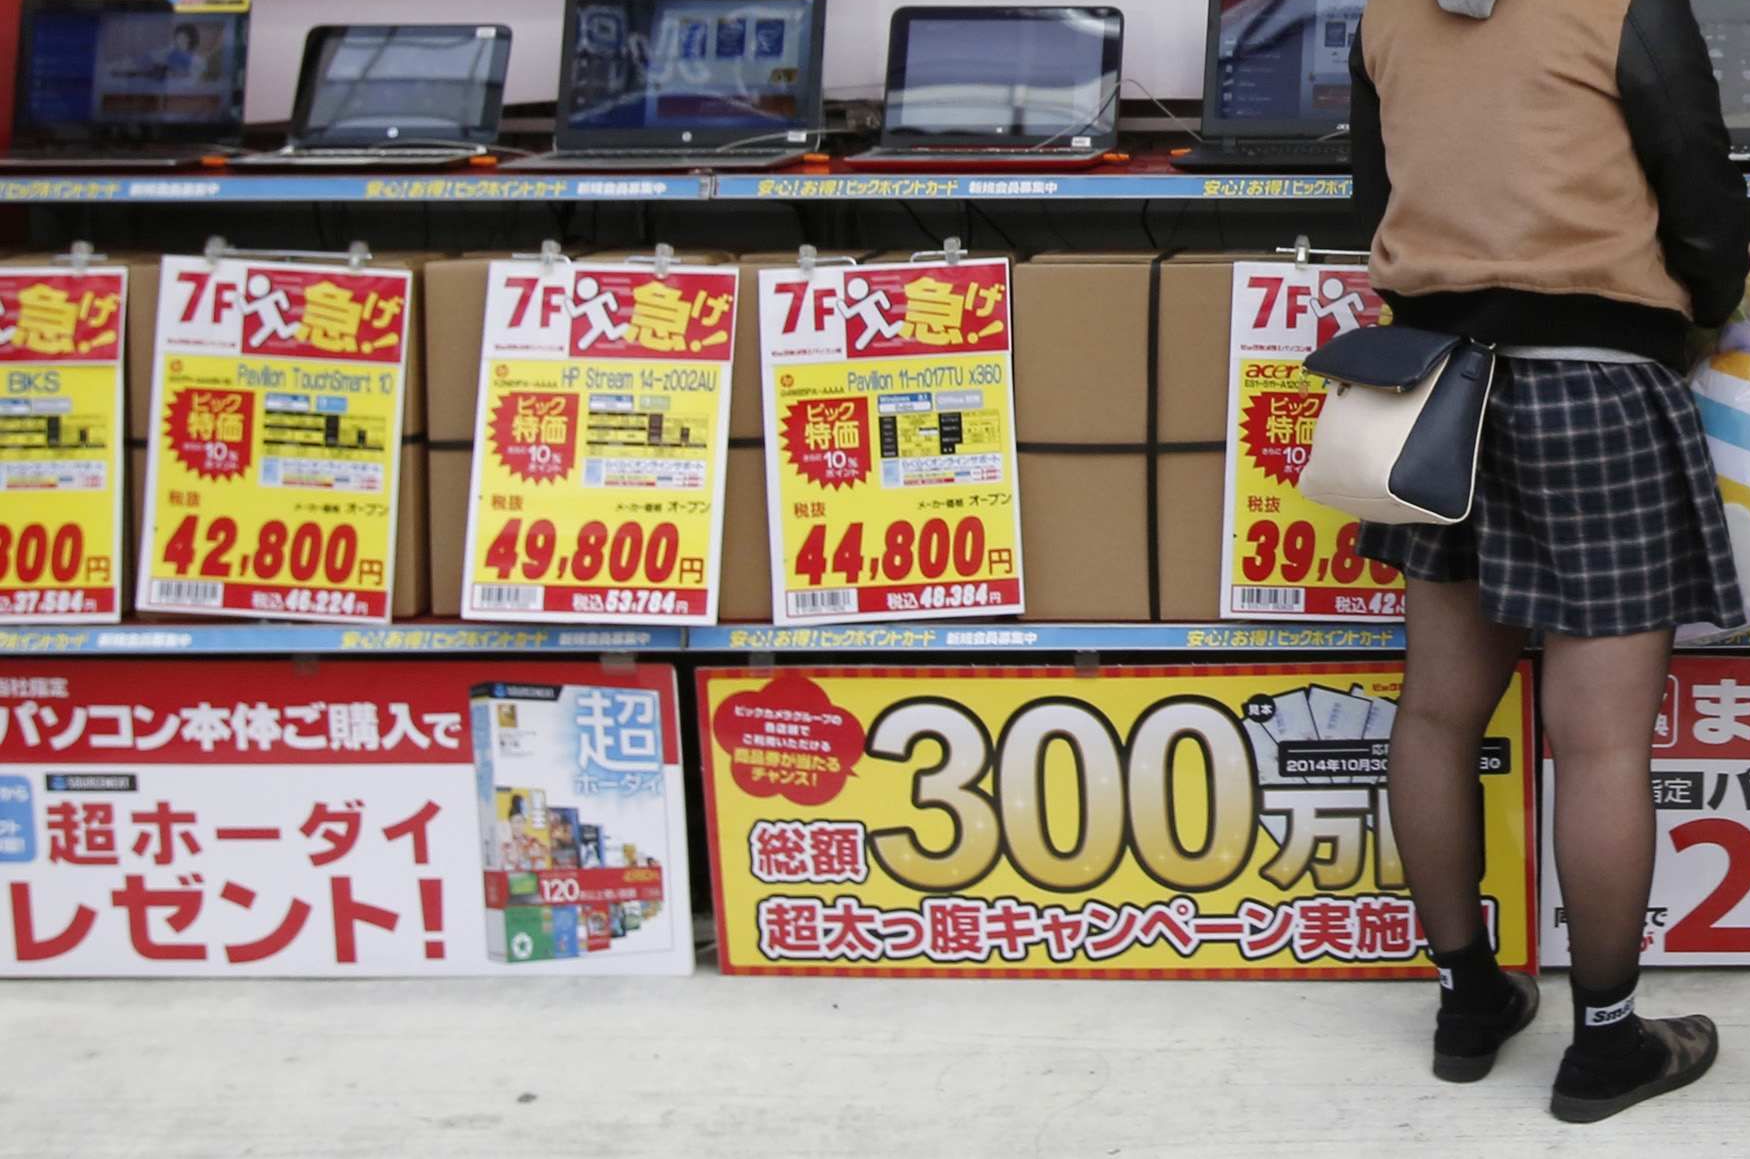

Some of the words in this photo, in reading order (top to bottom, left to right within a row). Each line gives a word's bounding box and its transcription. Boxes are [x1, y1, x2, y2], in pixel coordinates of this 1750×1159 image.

[176, 271, 238, 325] 7F
[774, 281, 838, 335] 7F
[896, 276, 1006, 346] 急げ!
[1247, 276, 1313, 330] 7F
[503, 276, 566, 329] 7F
[622, 278, 734, 354] 急げ!
[237, 363, 287, 388] Pavilion
[294, 366, 372, 394] TouchSmart
[562, 367, 580, 388] HP
[586, 367, 634, 390] Stream
[639, 369, 718, 393] 14-z002AU
[847, 370, 895, 391] Pavilion
[899, 365, 964, 388] 11-n017TU
[968, 363, 1003, 385] x360
[1245, 364, 1300, 380] acer
[517, 396, 567, 415] ビック
[806, 401, 856, 421] ビック
[1269, 397, 1320, 417] ビック
[511, 415, 569, 445] 特価
[803, 420, 861, 451] 特価
[527, 444, 562, 465] 10%
[822, 450, 859, 469] 10%
[666, 500, 712, 514] オープン
[793, 501, 826, 518] 税抜
[968, 492, 1013, 507] オープン
[1247, 495, 1281, 513] 税抜
[162, 512, 385, 587] 42,800円
[484, 517, 705, 585] 49,800円
[794, 515, 1014, 586] 44,800円
[571, 587, 690, 616] 税込53,784円
[885, 581, 1003, 610] 税込48,384円
[0, 701, 462, 752] パソコン本体ご購入で
[575, 692, 662, 773] 超
[751, 768, 819, 787] チャンス!
[750, 821, 868, 883] 総額
[866, 695, 1407, 896] 300万
[46, 800, 443, 868] 超ホーダイ
[542, 878, 581, 903] 120
[9, 872, 448, 965] レゼント!
